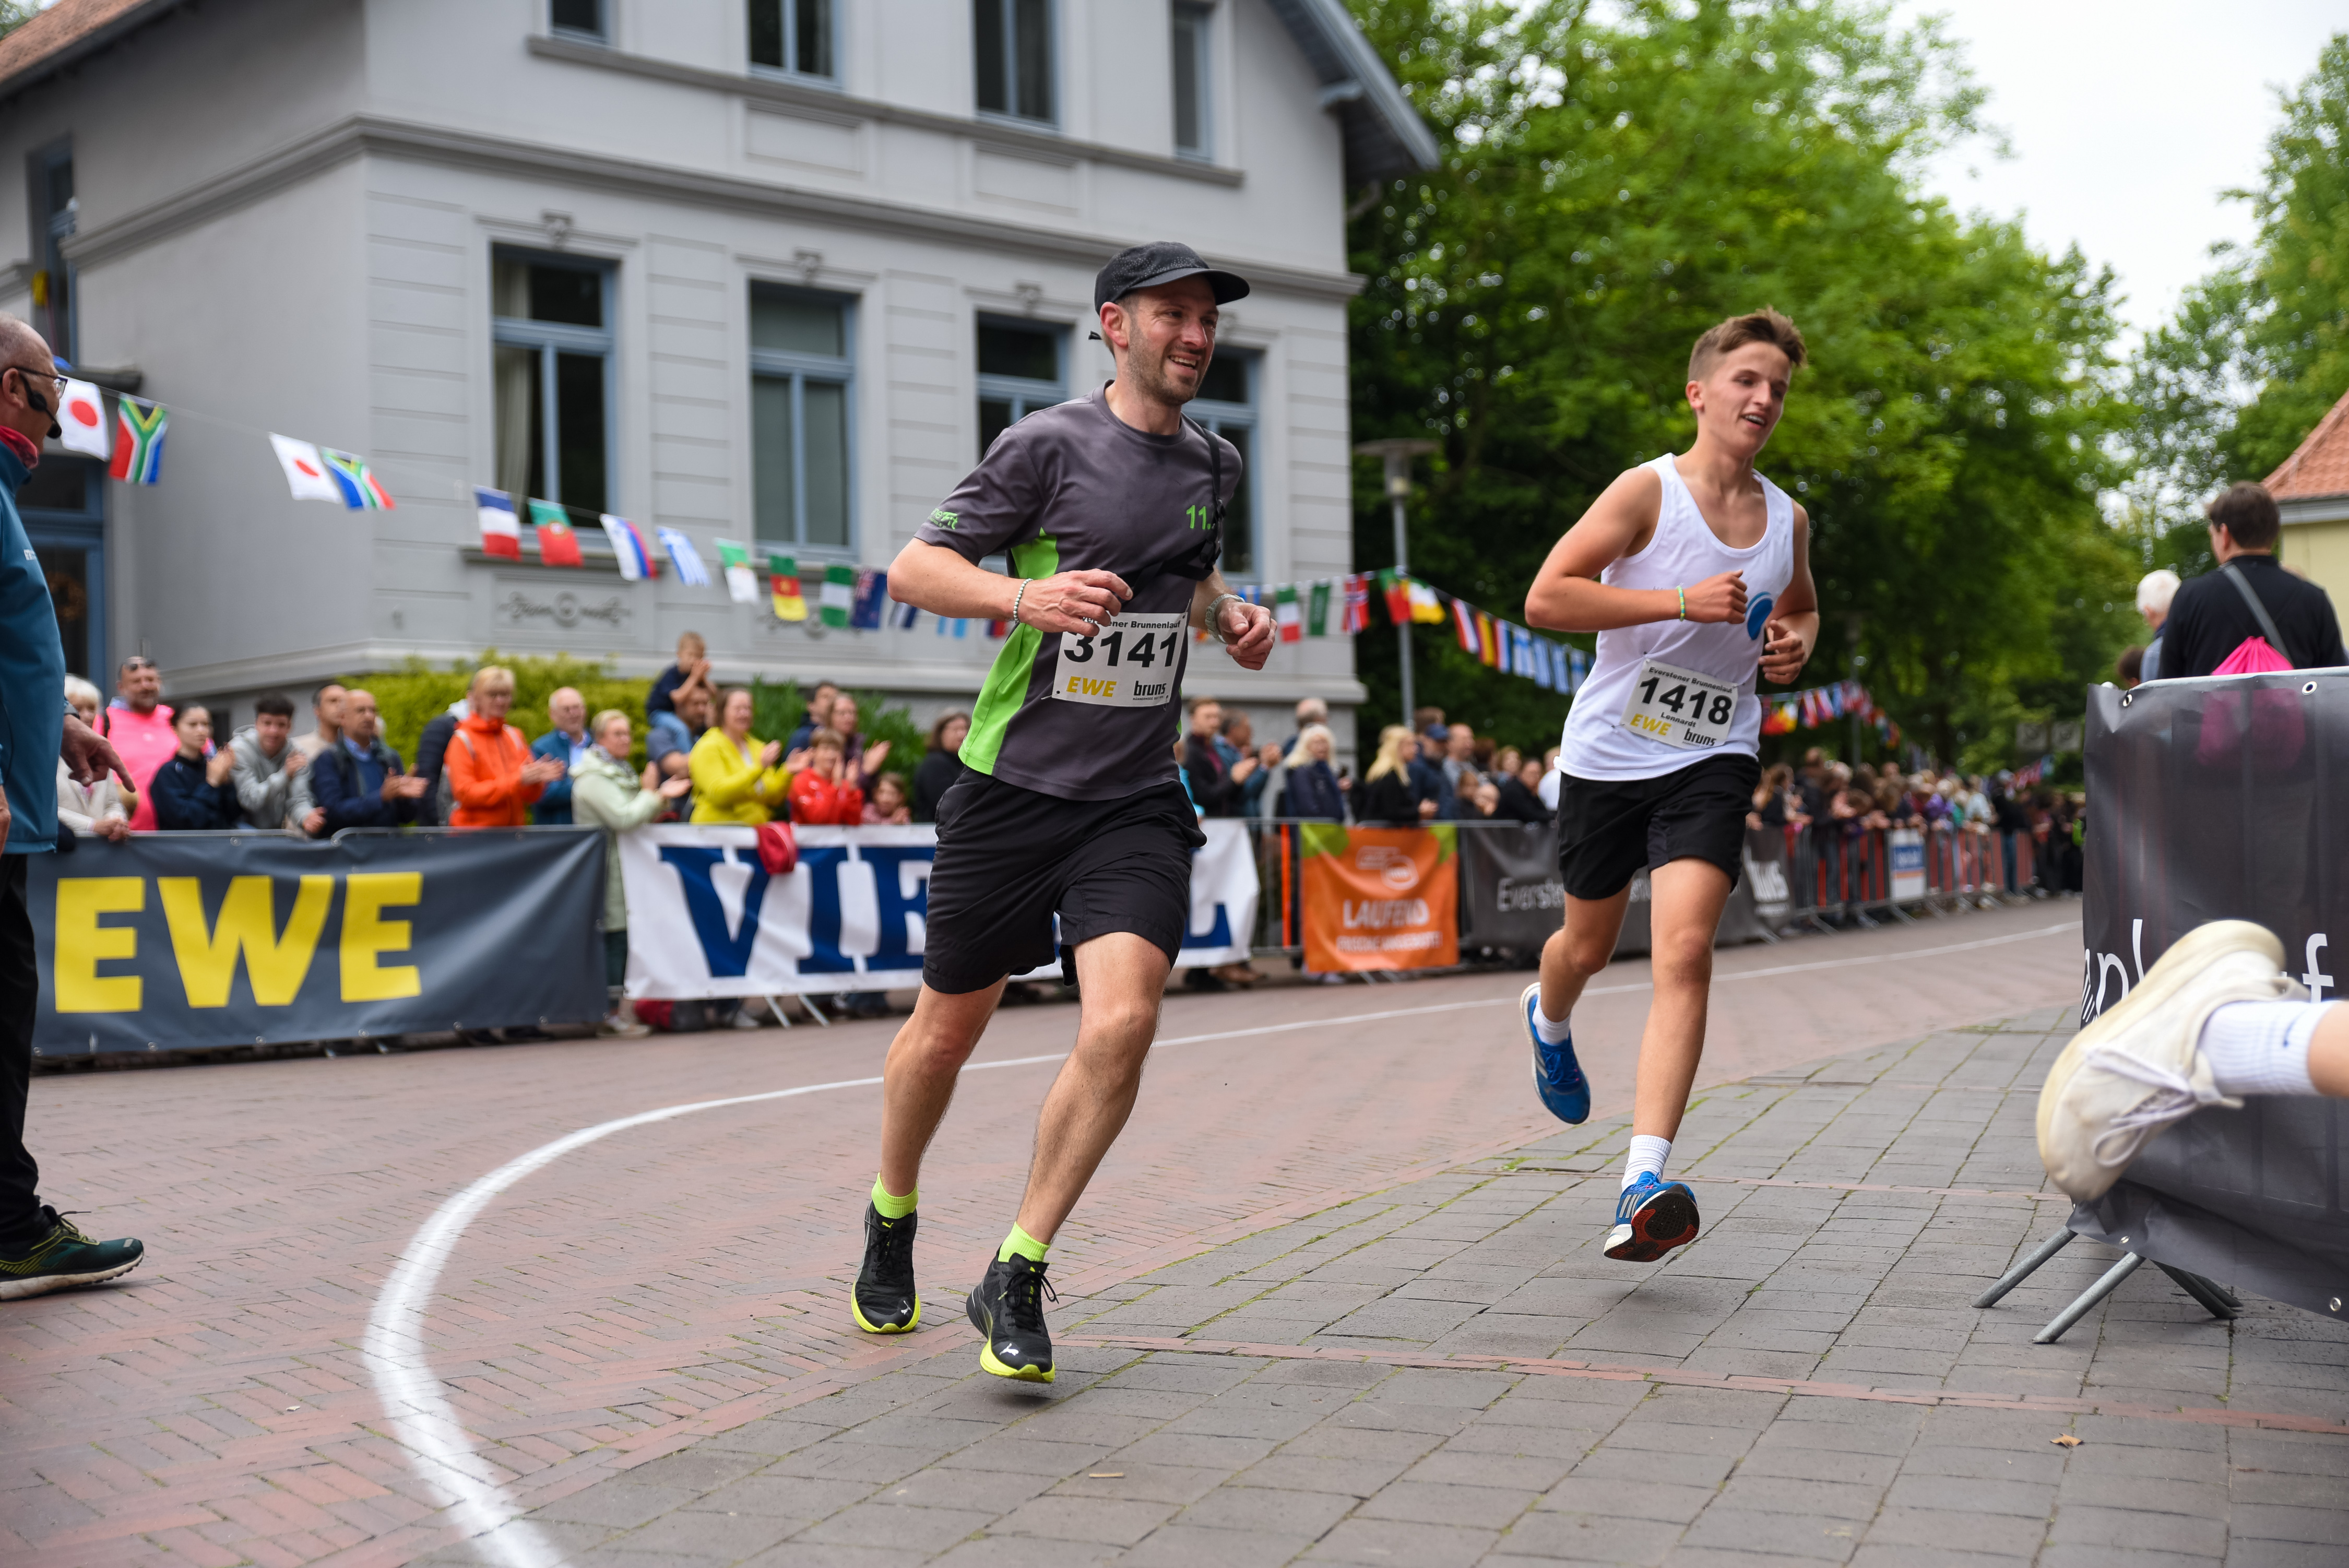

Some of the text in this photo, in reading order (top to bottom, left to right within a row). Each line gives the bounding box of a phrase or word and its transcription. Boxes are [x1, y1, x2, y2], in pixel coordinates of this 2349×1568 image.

[1186, 505, 1211, 530] 11.
[1131, 620, 1181, 629] Brunnenlauf
[1063, 631, 1178, 668] 3141
[1066, 676, 1117, 697] EWE
[1133, 680, 1167, 696] bruns
[1648, 667, 1733, 693] Everstener Brunnenlauf
[1640, 676, 1733, 725] 1418
[1630, 713, 1672, 736] EWE
[1660, 711, 1696, 727] Lennardt
[1683, 728, 1717, 746] bruns
[54, 871, 423, 1013] EWE
